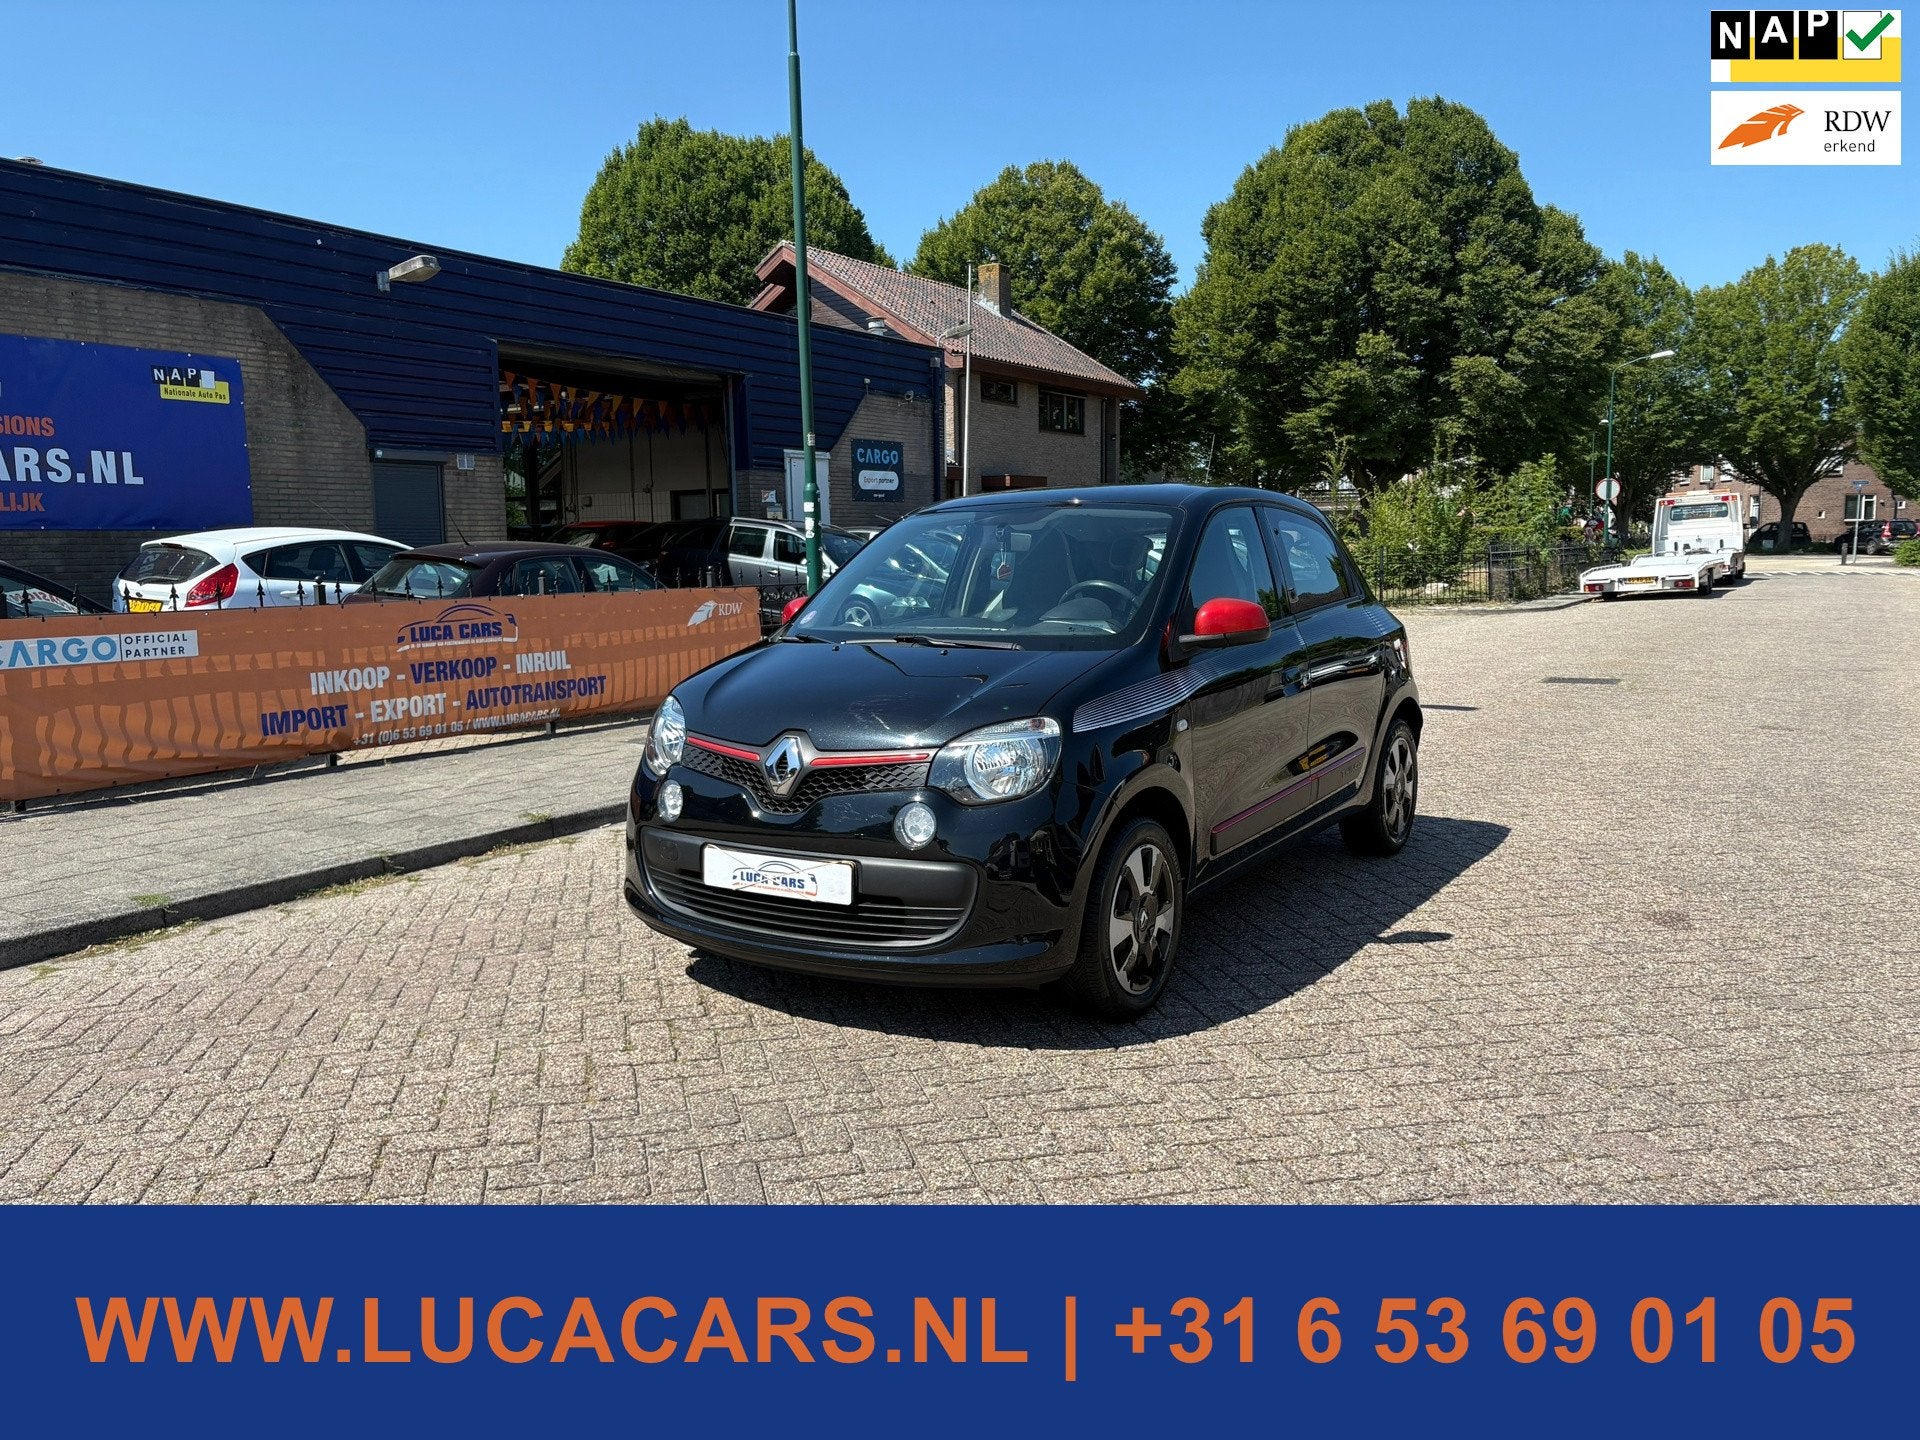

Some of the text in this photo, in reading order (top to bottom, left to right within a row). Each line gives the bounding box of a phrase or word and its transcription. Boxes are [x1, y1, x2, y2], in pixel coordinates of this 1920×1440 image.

[153, 368, 197, 381] NAP
[164, 387, 226, 400] Nationale Auto Pas
[0, 415, 55, 437] IONS
[857, 447, 899, 465] CARGO
[718, 602, 743, 616] RDW
[124, 633, 188, 645] OFFICIAL
[410, 622, 502, 642] LUCA CARS
[0, 636, 118, 667] ARGO
[125, 646, 186, 659] PARTNER
[310, 666, 391, 695] INKOOP
[410, 656, 498, 685] VERKOOP
[516, 650, 572, 674] INRUIL
[261, 704, 348, 737] IMPORT
[370, 693, 447, 723] EXPORT
[466, 675, 607, 711] AUTOTRANSPORT
[353, 733, 374, 746] +31
[378, 730, 400, 745] (0)6
[402, 728, 416, 740] 53
[419, 725, 432, 737] 69
[435, 723, 447, 735] 01
[450, 720, 463, 733] 05
[472, 708, 561, 730] WWW.LUCACARS.NL
